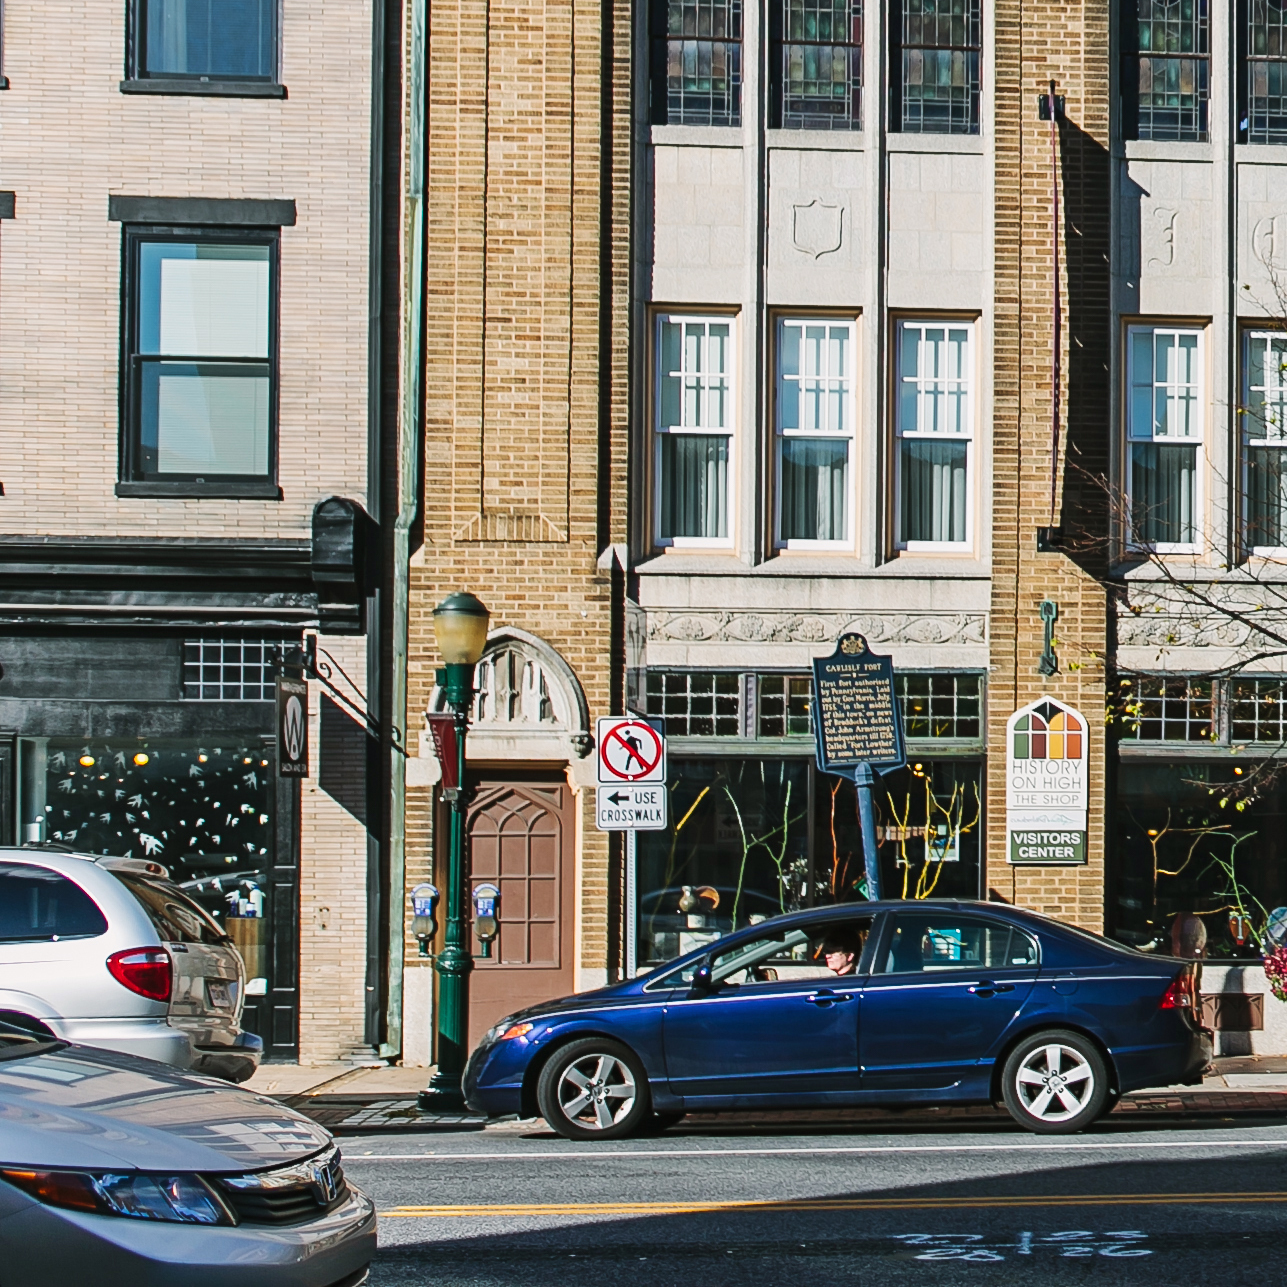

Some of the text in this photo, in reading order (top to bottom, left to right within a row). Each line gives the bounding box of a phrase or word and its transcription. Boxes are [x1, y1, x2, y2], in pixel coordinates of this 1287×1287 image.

[864, 662, 882, 671] FORT
[820, 679, 836, 687] First
[820, 688, 830, 696] by
[876, 685, 890, 693] Laid
[832, 695, 841, 703] by
[854, 702, 865, 710] the
[823, 711, 831, 719] of
[833, 710, 845, 718] this
[825, 734, 868, 742] headquarters
[869, 732, 879, 740] till
[826, 742, 847, 750] Called
[827, 751, 836, 759] by
[1012, 760, 1081, 775] HISTORY
[1012, 776, 1081, 789] ON HIGH
[635, 792, 657, 804] USE
[1015, 794, 1079, 804] THE SHOP
[601, 809, 662, 822] CROSSWALK
[1013, 832, 1081, 845] VISITORS
[1018, 846, 1074, 858] CENTER
